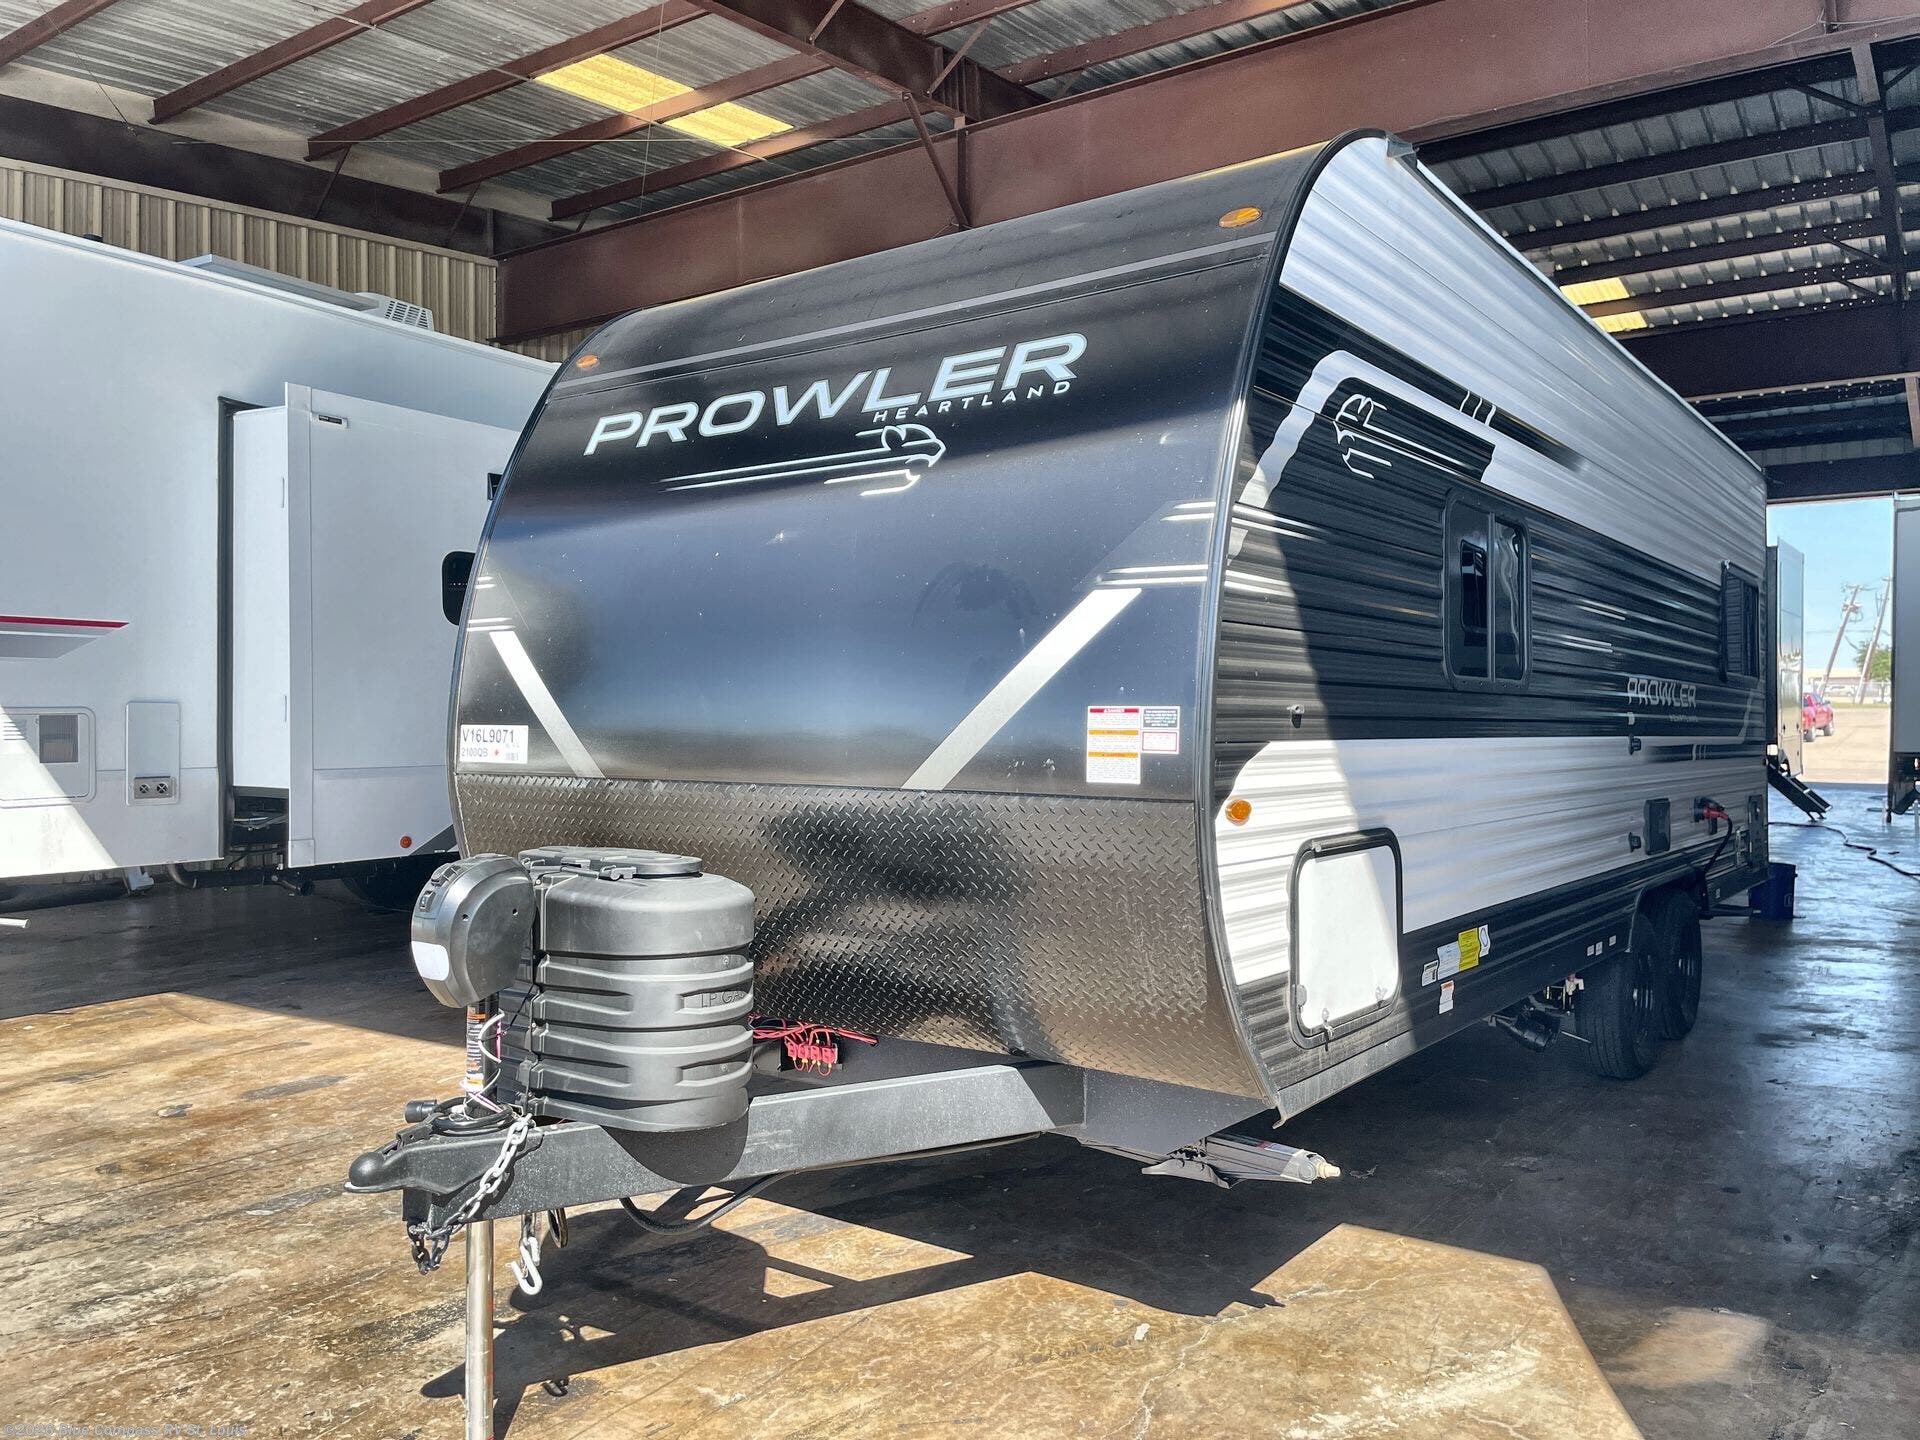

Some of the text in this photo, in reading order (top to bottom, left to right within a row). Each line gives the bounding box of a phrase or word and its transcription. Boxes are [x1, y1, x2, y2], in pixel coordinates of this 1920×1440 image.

[583, 333, 1088, 456] PROWLER
[872, 381, 1070, 423] HEARTLAND
[1628, 677, 1697, 708] PROWLER
[462, 728, 514, 743] V16L9071
